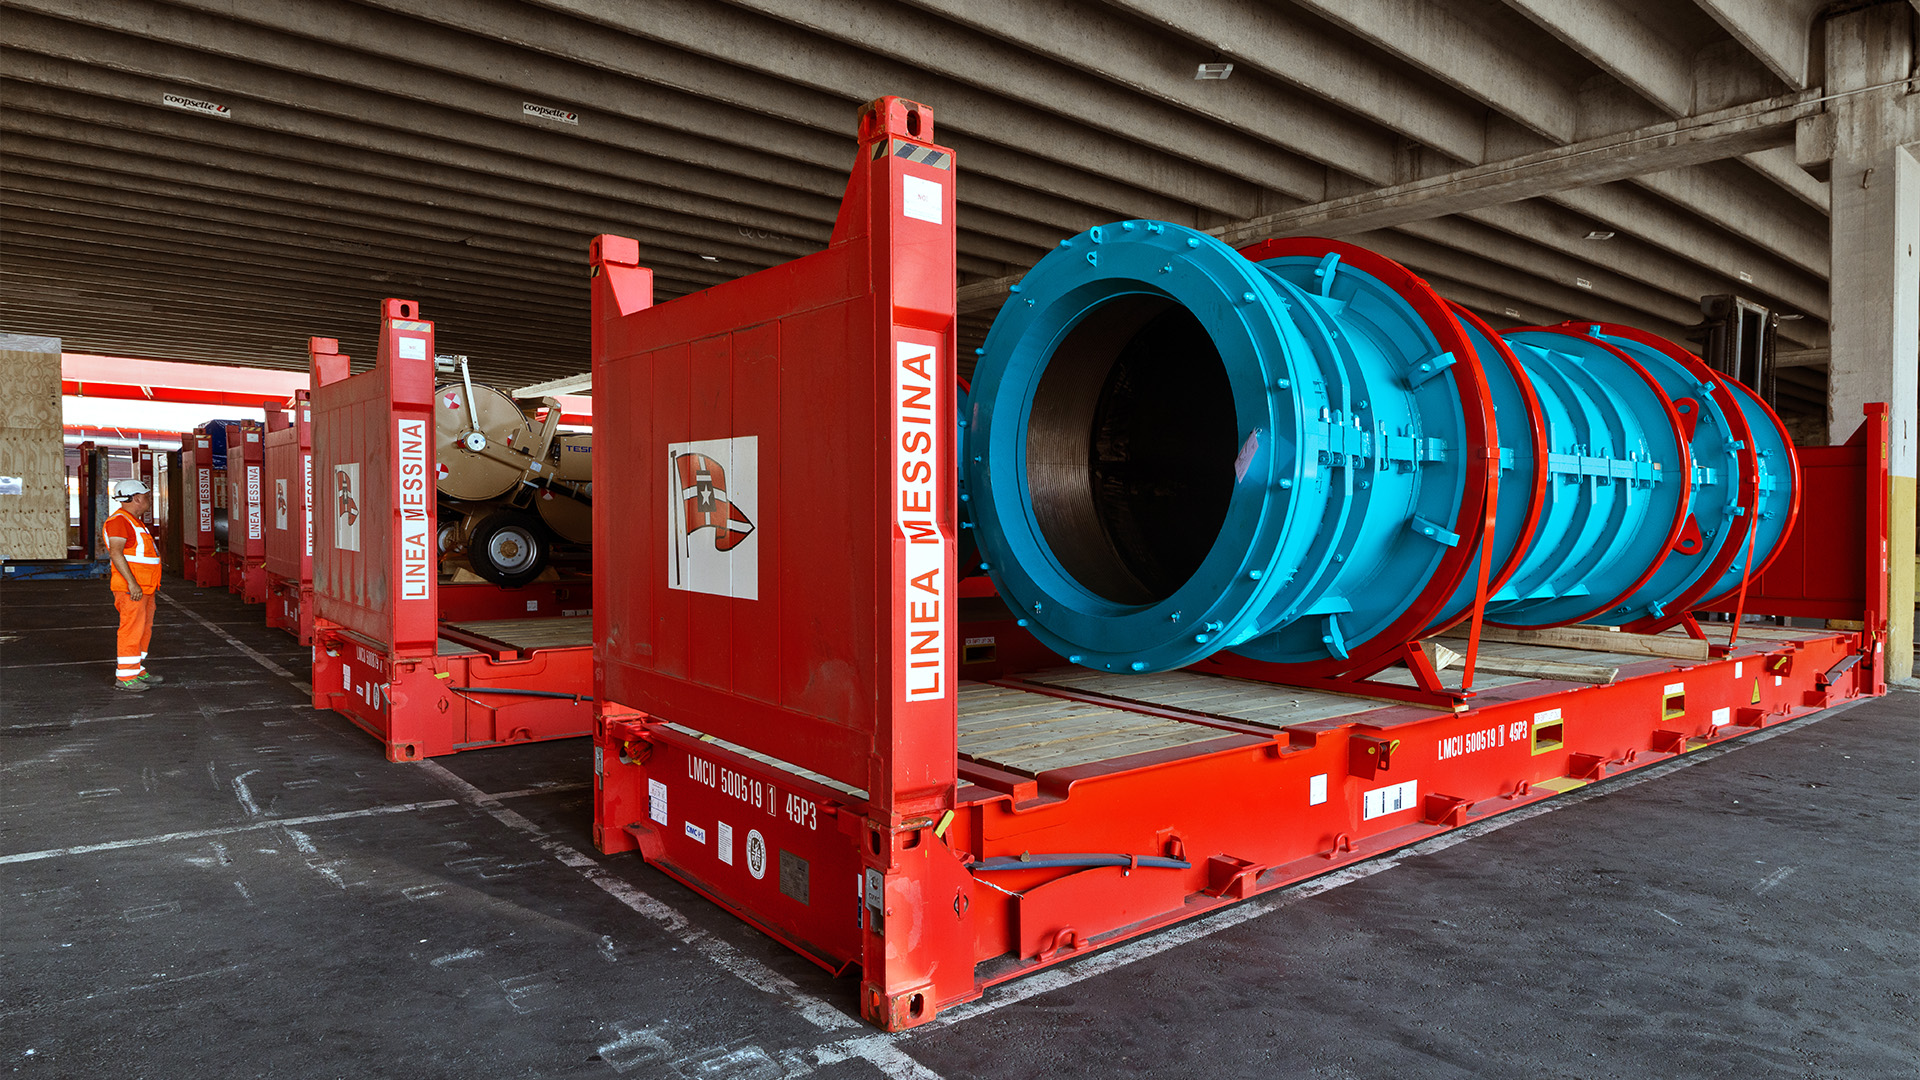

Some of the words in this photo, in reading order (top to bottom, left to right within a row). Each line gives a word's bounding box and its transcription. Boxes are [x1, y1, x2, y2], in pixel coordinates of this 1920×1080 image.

[164, 95, 214, 110] coopsette
[524, 104, 565, 118] coopsette
[902, 353, 939, 544] MESSINA
[248, 467, 259, 508] MESSINA
[402, 424, 425, 521] MESSINA
[202, 507, 211, 531] LINEA
[250, 511, 260, 538] LINEA
[405, 533, 426, 597] LINEA
[911, 568, 939, 695] LINEA
[1438, 735, 1463, 760] LMCU
[1465, 726, 1496, 754] 500519
[1509, 720, 1528, 742] 45P3
[688, 754, 716, 788] LMCU
[721, 767, 762, 808] 500519
[785, 793, 817, 831] 45P3
